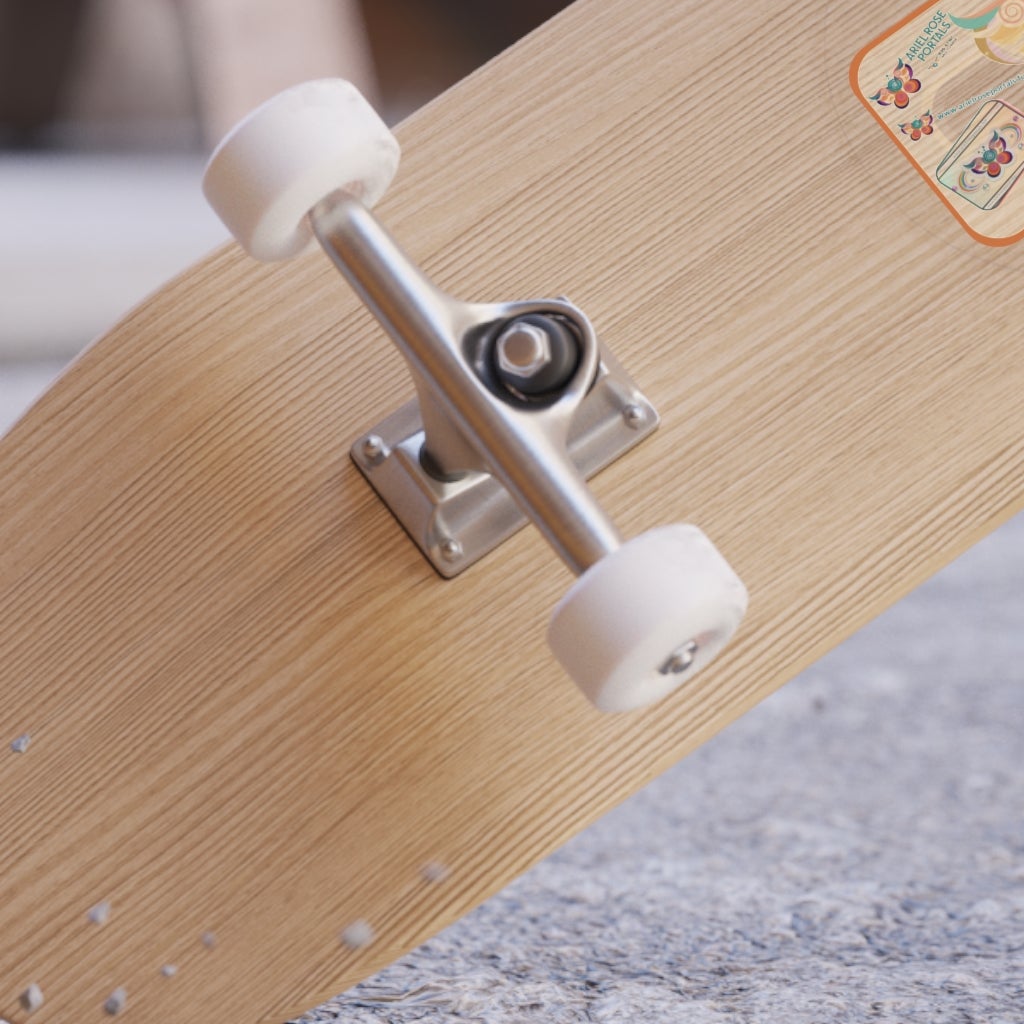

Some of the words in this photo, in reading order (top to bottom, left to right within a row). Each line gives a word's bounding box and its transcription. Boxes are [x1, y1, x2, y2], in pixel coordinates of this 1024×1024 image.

[905, 35, 929, 61] ARIEL
[923, 10, 947, 36] ROSE
[917, 21, 951, 62] PORTALS
